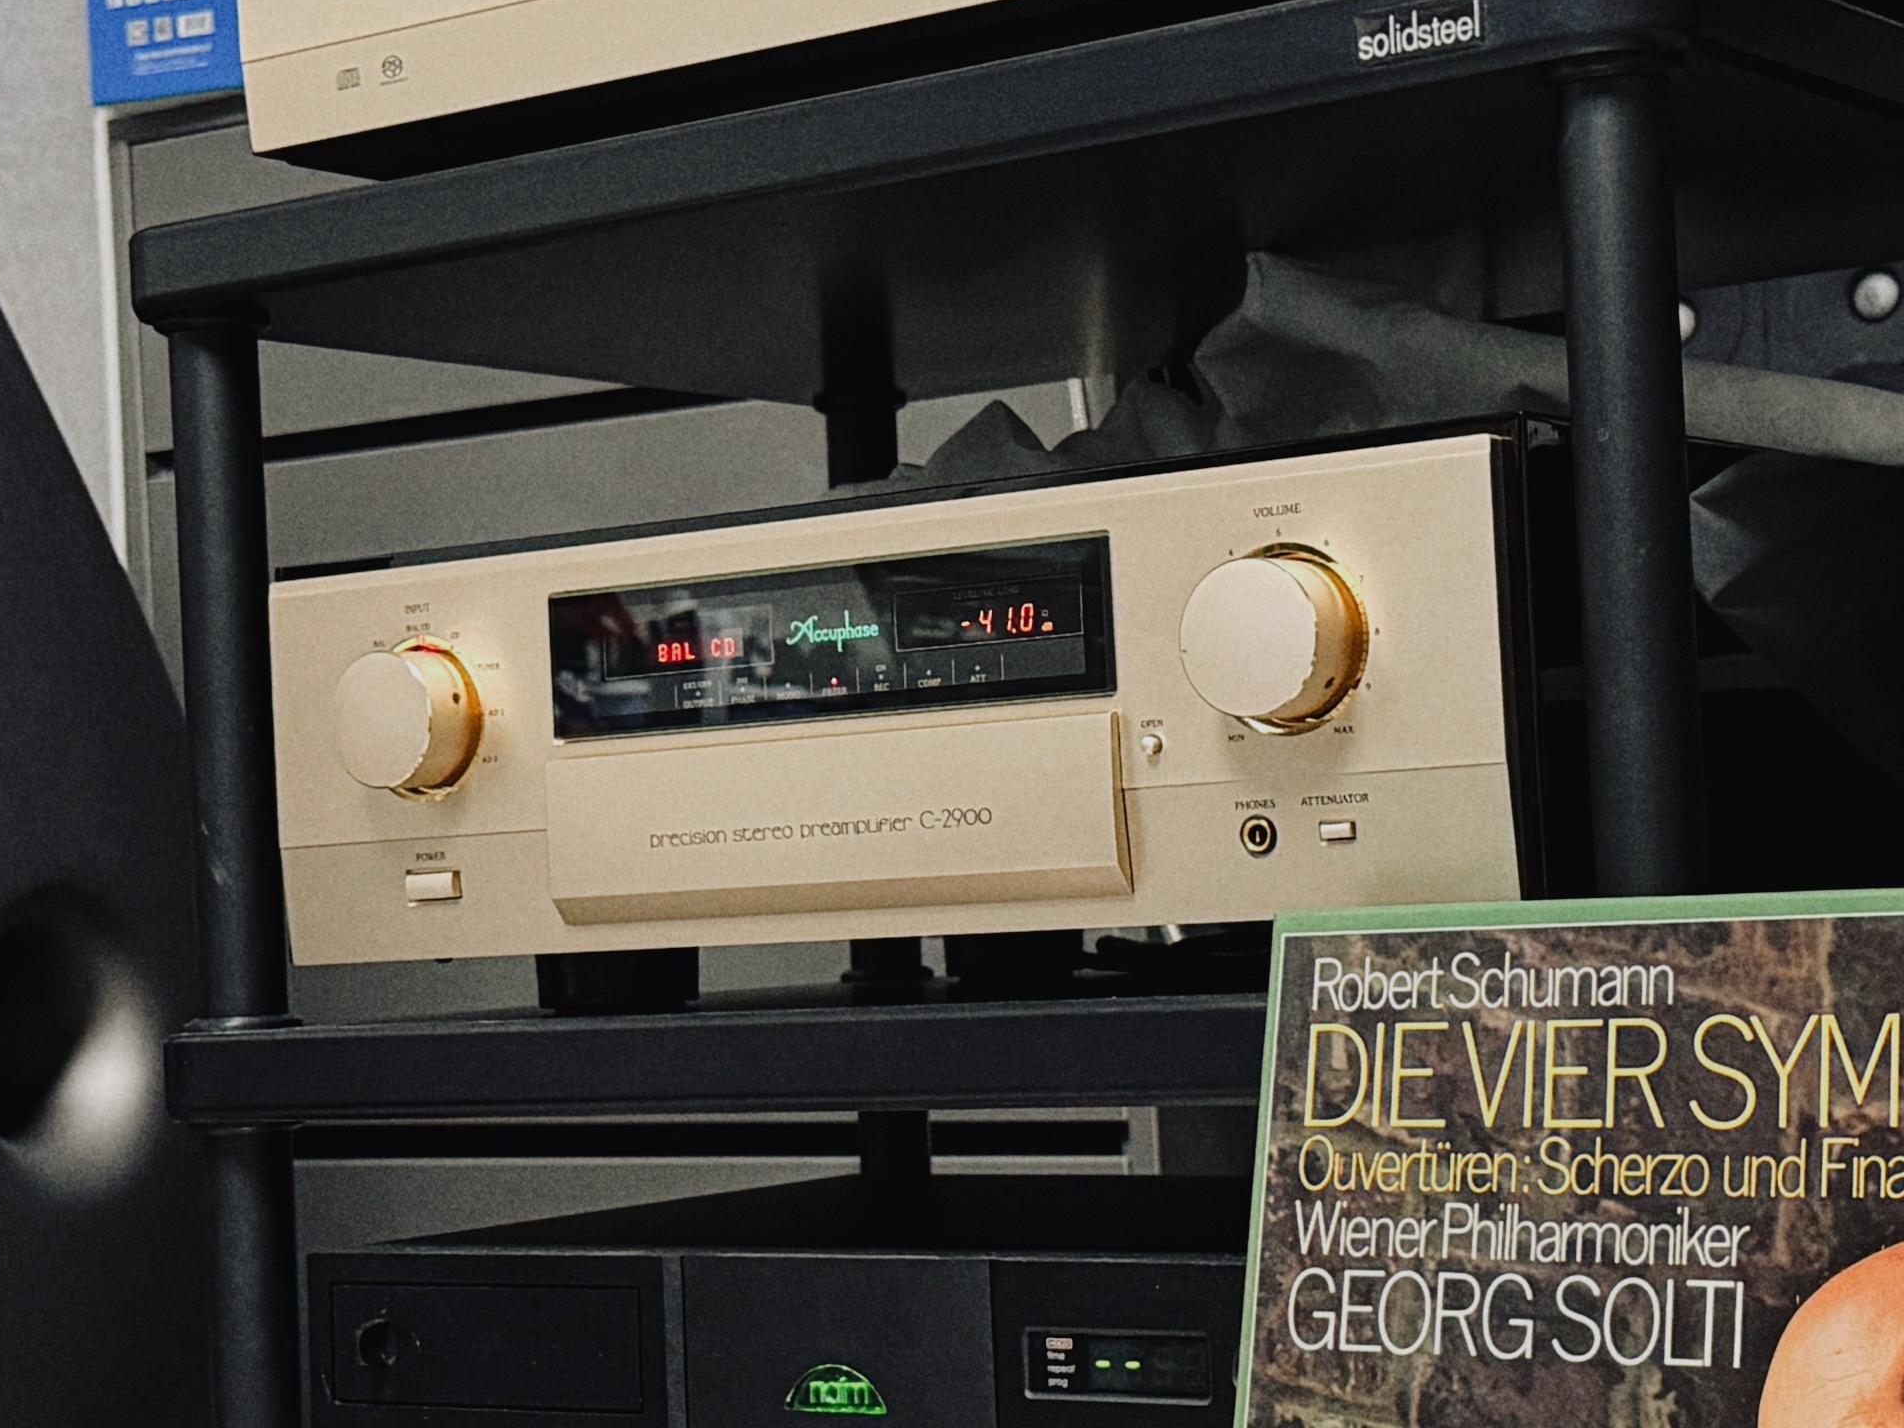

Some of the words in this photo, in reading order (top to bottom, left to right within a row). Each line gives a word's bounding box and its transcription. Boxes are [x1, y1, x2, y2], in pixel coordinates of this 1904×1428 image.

[1252, 503, 1302, 519] VOLUME
[404, 603, 430, 615] INPUT
[785, 610, 880, 653] Accuphase
[657, 642, 696, 663] BAL
[710, 637, 736, 658] CD
[1333, 724, 1355, 735] MAX
[1234, 799, 1277, 811] PHONES
[1300, 793, 1370, 807] ATTENUATOR
[650, 829, 728, 850] precision
[732, 823, 794, 843] stereo
[919, 807, 993, 830] C-2900
[415, 851, 447, 862] POWER
[1310, 956, 1446, 1012] Robert
[1448, 951, 1675, 1010] Schumann
[1303, 1022, 1450, 1129] DIE
[1462, 1017, 1669, 1130] VIER
[1536, 1136, 1711, 1198] Scherzo
[1723, 1138, 1807, 1199] und
[1295, 1199, 1439, 1259] Wiener
[1441, 1202, 1752, 1268] Philharmoniker
[1287, 1267, 1535, 1362] GEORG
[1551, 1274, 1746, 1370] SOLTI
